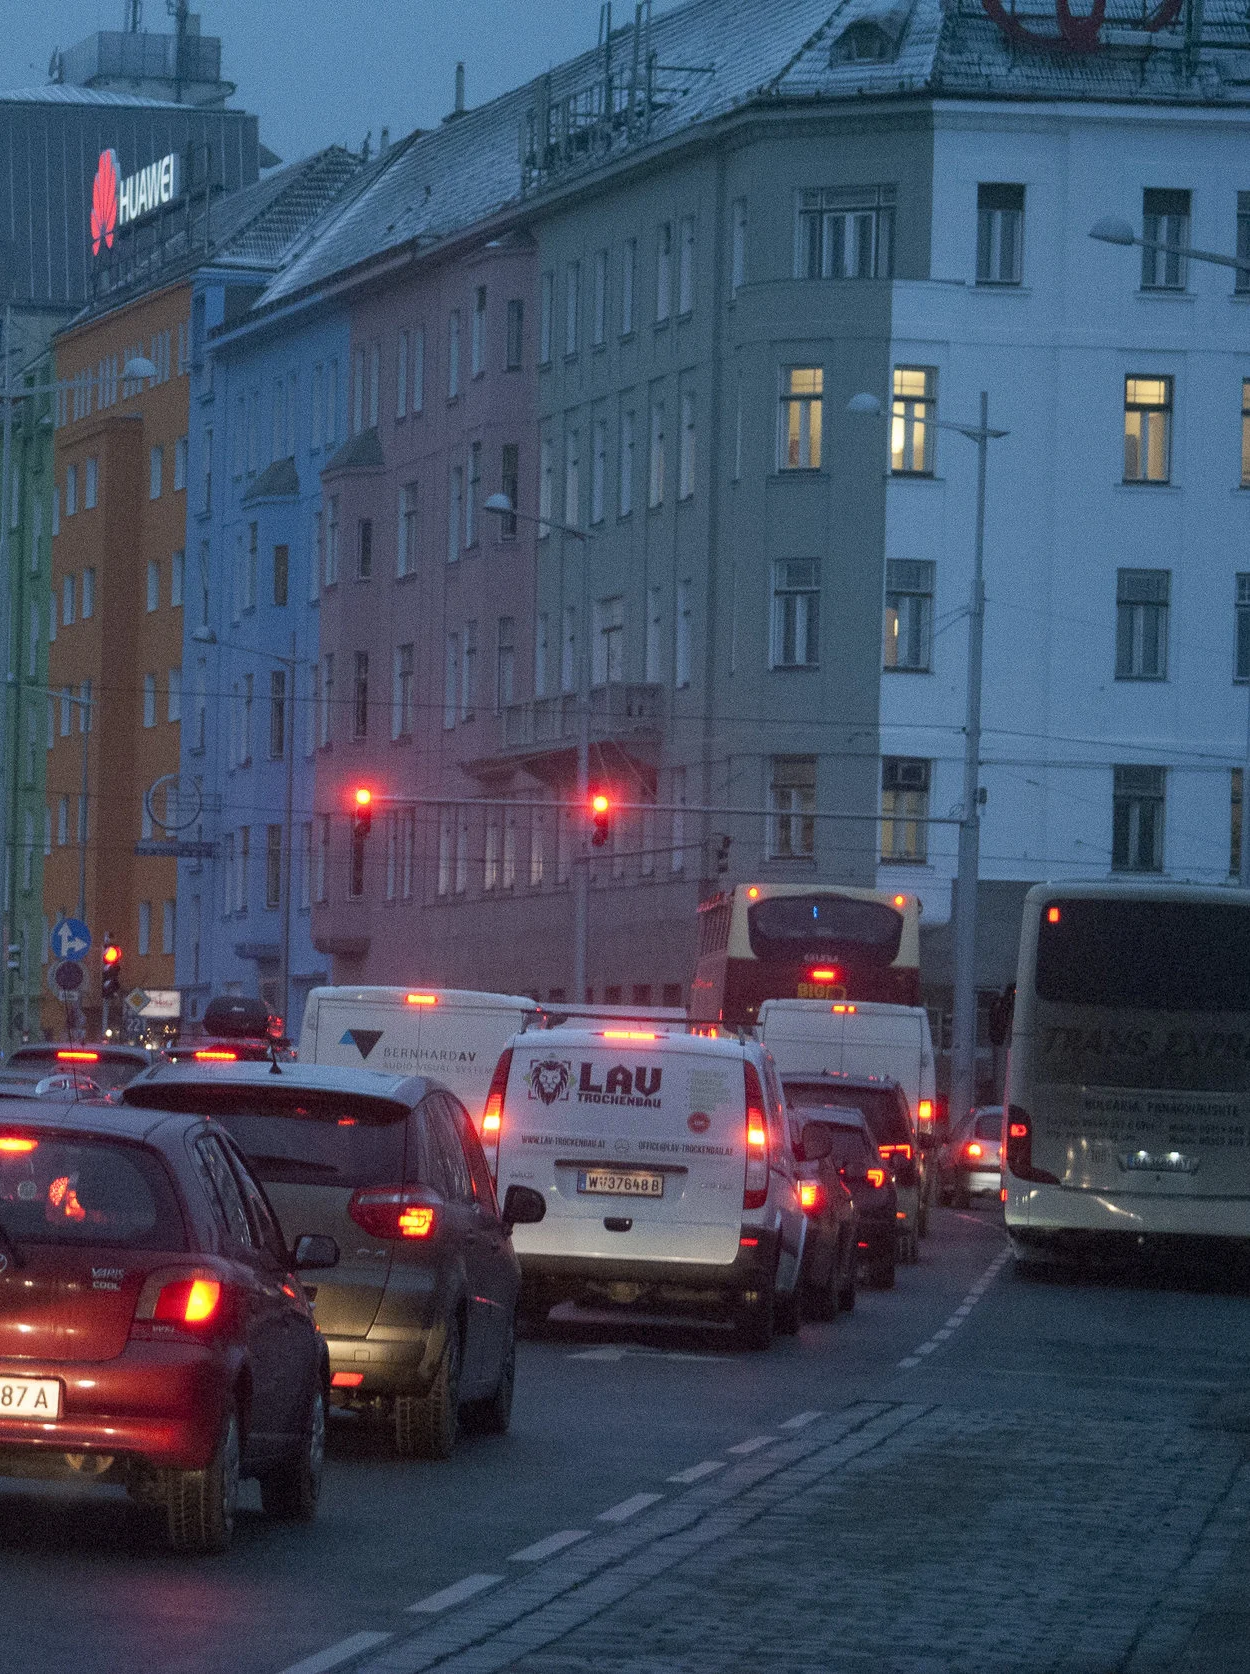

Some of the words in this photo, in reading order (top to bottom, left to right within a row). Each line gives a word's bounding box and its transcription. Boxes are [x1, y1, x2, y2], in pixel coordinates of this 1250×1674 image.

[119, 153, 174, 225] HUAWEI
[579, 1062, 663, 1097] LAV
[588, 1176, 599, 1188] W
[607, 1176, 649, 1191] 37648
[651, 1179, 660, 1191] B
[92, 1281, 121, 1291] COOL
[33, 1387, 48, 1409] A
